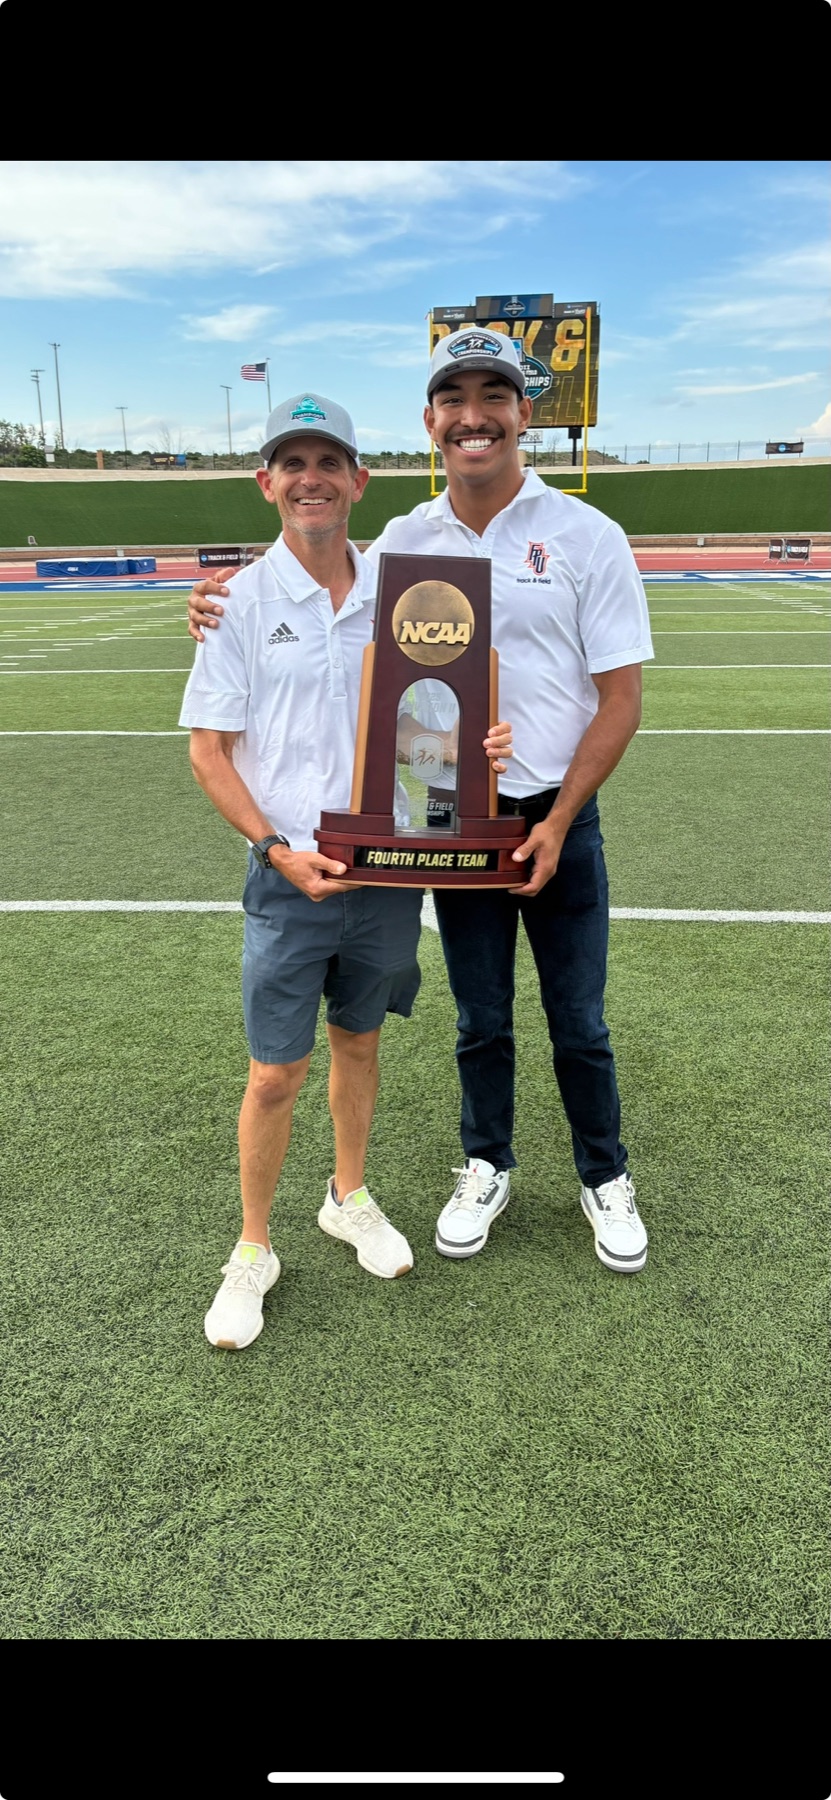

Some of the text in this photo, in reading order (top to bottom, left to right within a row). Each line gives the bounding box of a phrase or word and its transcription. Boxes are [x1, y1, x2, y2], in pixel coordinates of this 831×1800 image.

[525, 376, 550, 387] SHIPS
[399, 620, 471, 645] NCAA
[268, 635, 300, 645] adidas
[428, 802, 454, 811] & FIELD
[366, 851, 488, 867] FOURTH PLACE TEAM
